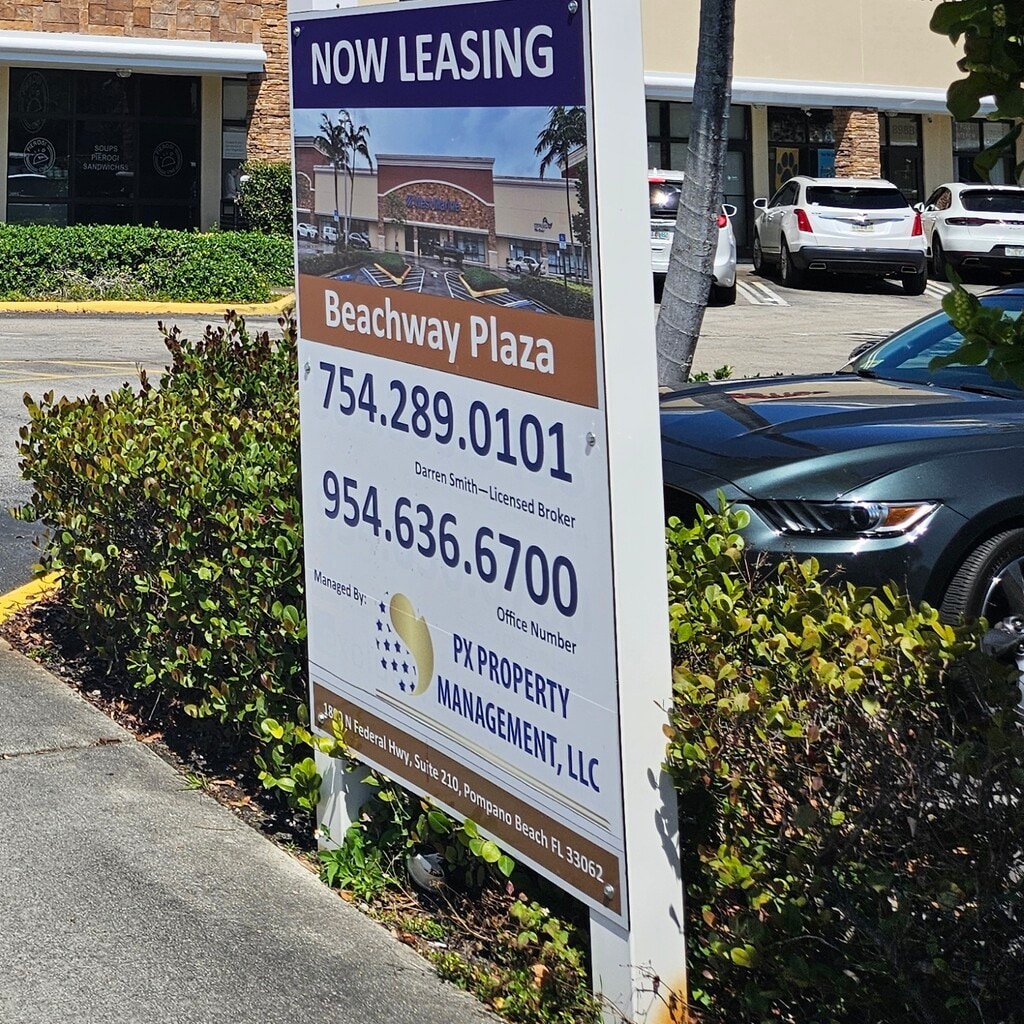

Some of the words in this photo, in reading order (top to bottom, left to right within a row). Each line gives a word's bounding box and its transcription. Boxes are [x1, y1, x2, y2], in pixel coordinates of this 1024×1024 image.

[311, 36, 388, 85] NOW
[399, 24, 554, 82] LEASING
[83, 163, 129, 171] SANDWICHES
[91, 154, 120, 162] PIEROGI
[94, 145, 118, 153] SOUPS
[325, 289, 460, 364] Beachway
[470, 315, 555, 375] Plaza
[319, 361, 572, 483] 754.289.0101
[414, 461, 447, 484] Darren
[538, 501, 576, 528] Broker
[322, 470, 578, 618] 954.636.6700
[314, 569, 352, 597] Managed
[353, 587, 367, 605] By:
[497, 606, 528, 633] Office
[531, 620, 577, 654] Number
[453, 633, 474, 673] PX
[477, 645, 570, 719] PROPERTY
[437, 675, 562, 776] MANAGEMENT,
[568, 744, 601, 793] LLC
[345, 714, 352, 731] N
[354, 721, 387, 750] Federal
[388, 739, 413, 767] Hwy,
[414, 754, 439, 780] Suite
[440, 769, 462, 797] 210,
[464, 783, 512, 826] Pompano
[515, 815, 548, 849] Beach
[551, 836, 564, 859] FL
[566, 846, 605, 884] 33062
